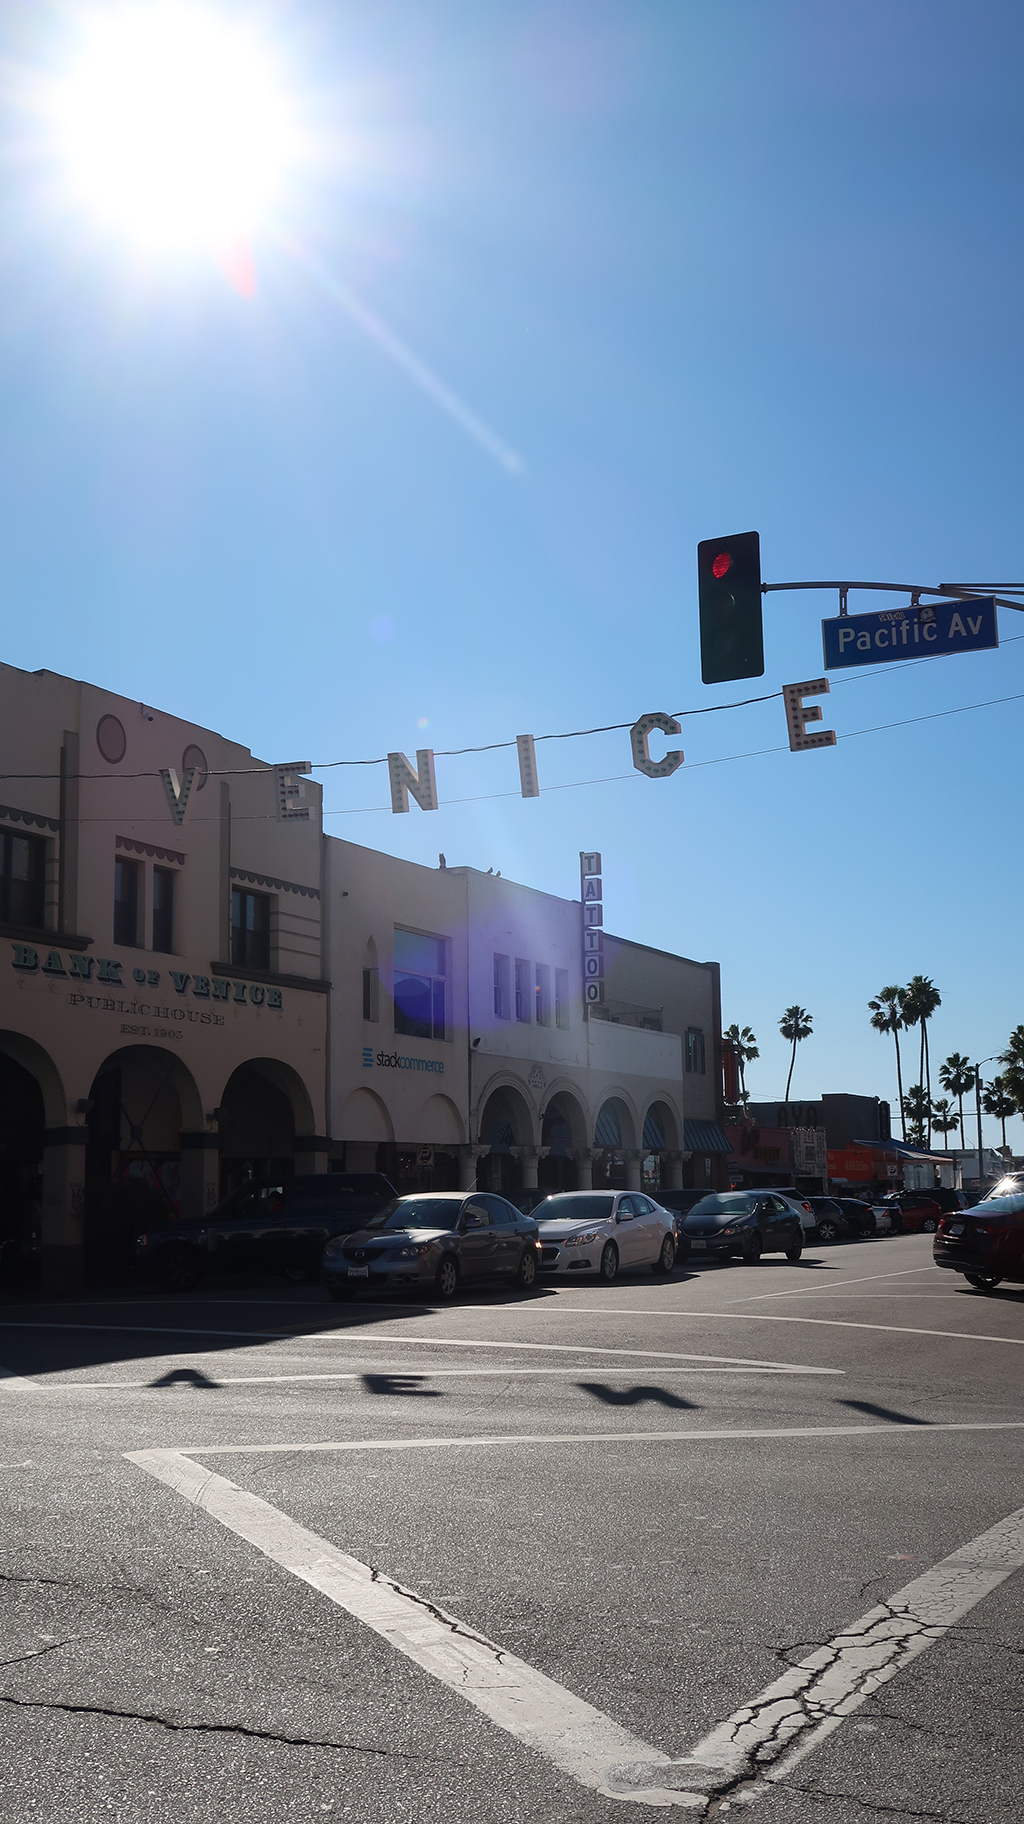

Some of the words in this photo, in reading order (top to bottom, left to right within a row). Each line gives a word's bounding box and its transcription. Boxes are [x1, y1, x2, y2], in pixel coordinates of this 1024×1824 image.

[838, 618, 938, 653] Pacific
[948, 612, 985, 639] Av
[159, 677, 837, 826] VENICE
[584, 855, 599, 1002] TATTOO
[11, 943, 124, 986] BANK
[131, 968, 161, 985] OF
[169, 970, 284, 1009] VENICE
[68, 993, 151, 1016] PUBLIC
[153, 1006, 225, 1027] HOUSE
[120, 1023, 151, 1036] EST.
[153, 1028, 184, 1041] 1905
[376, 1050, 445, 1074] stackcommerce
[777, 1105, 818, 1128] AYA
